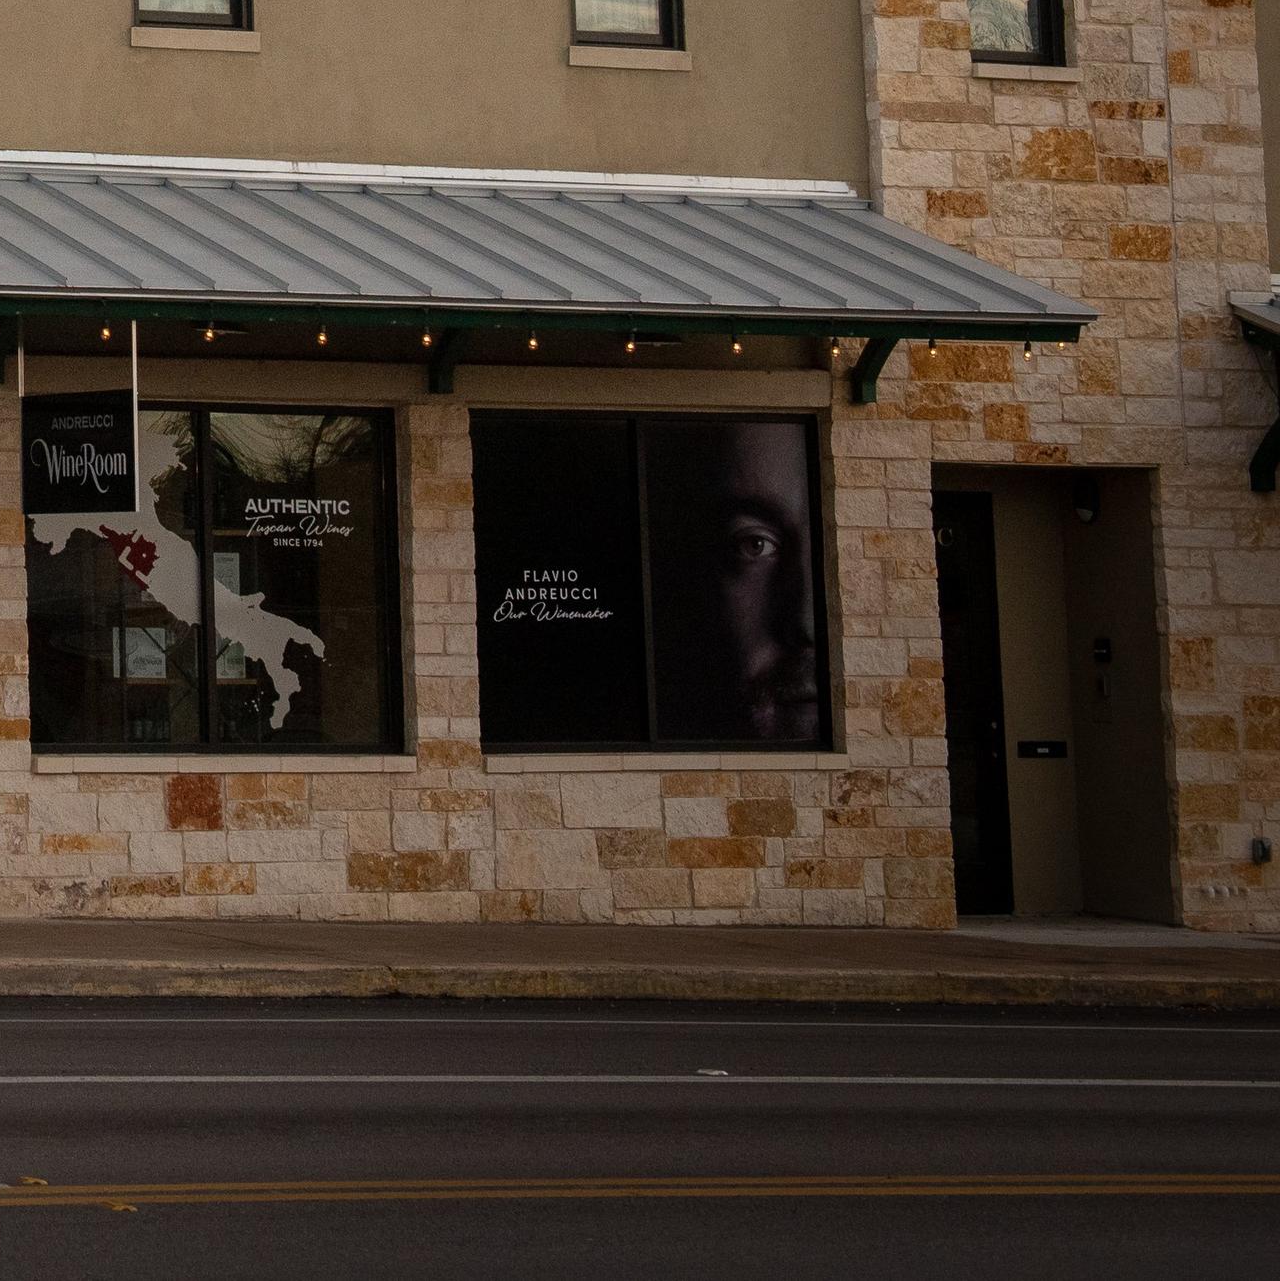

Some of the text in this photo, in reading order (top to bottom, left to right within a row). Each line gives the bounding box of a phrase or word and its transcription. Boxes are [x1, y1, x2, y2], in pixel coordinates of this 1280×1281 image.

[51, 414, 115, 431] ANDREUCCI
[244, 497, 351, 516] AUTHENTIC
[244, 514, 354, 538] Tuscan Wines
[273, 537, 325, 548] SINCE 1794
[523, 569, 579, 583] FLAVIO
[505, 587, 598, 601] ANDREUCCI
[493, 600, 614, 623] Our Winemaker
